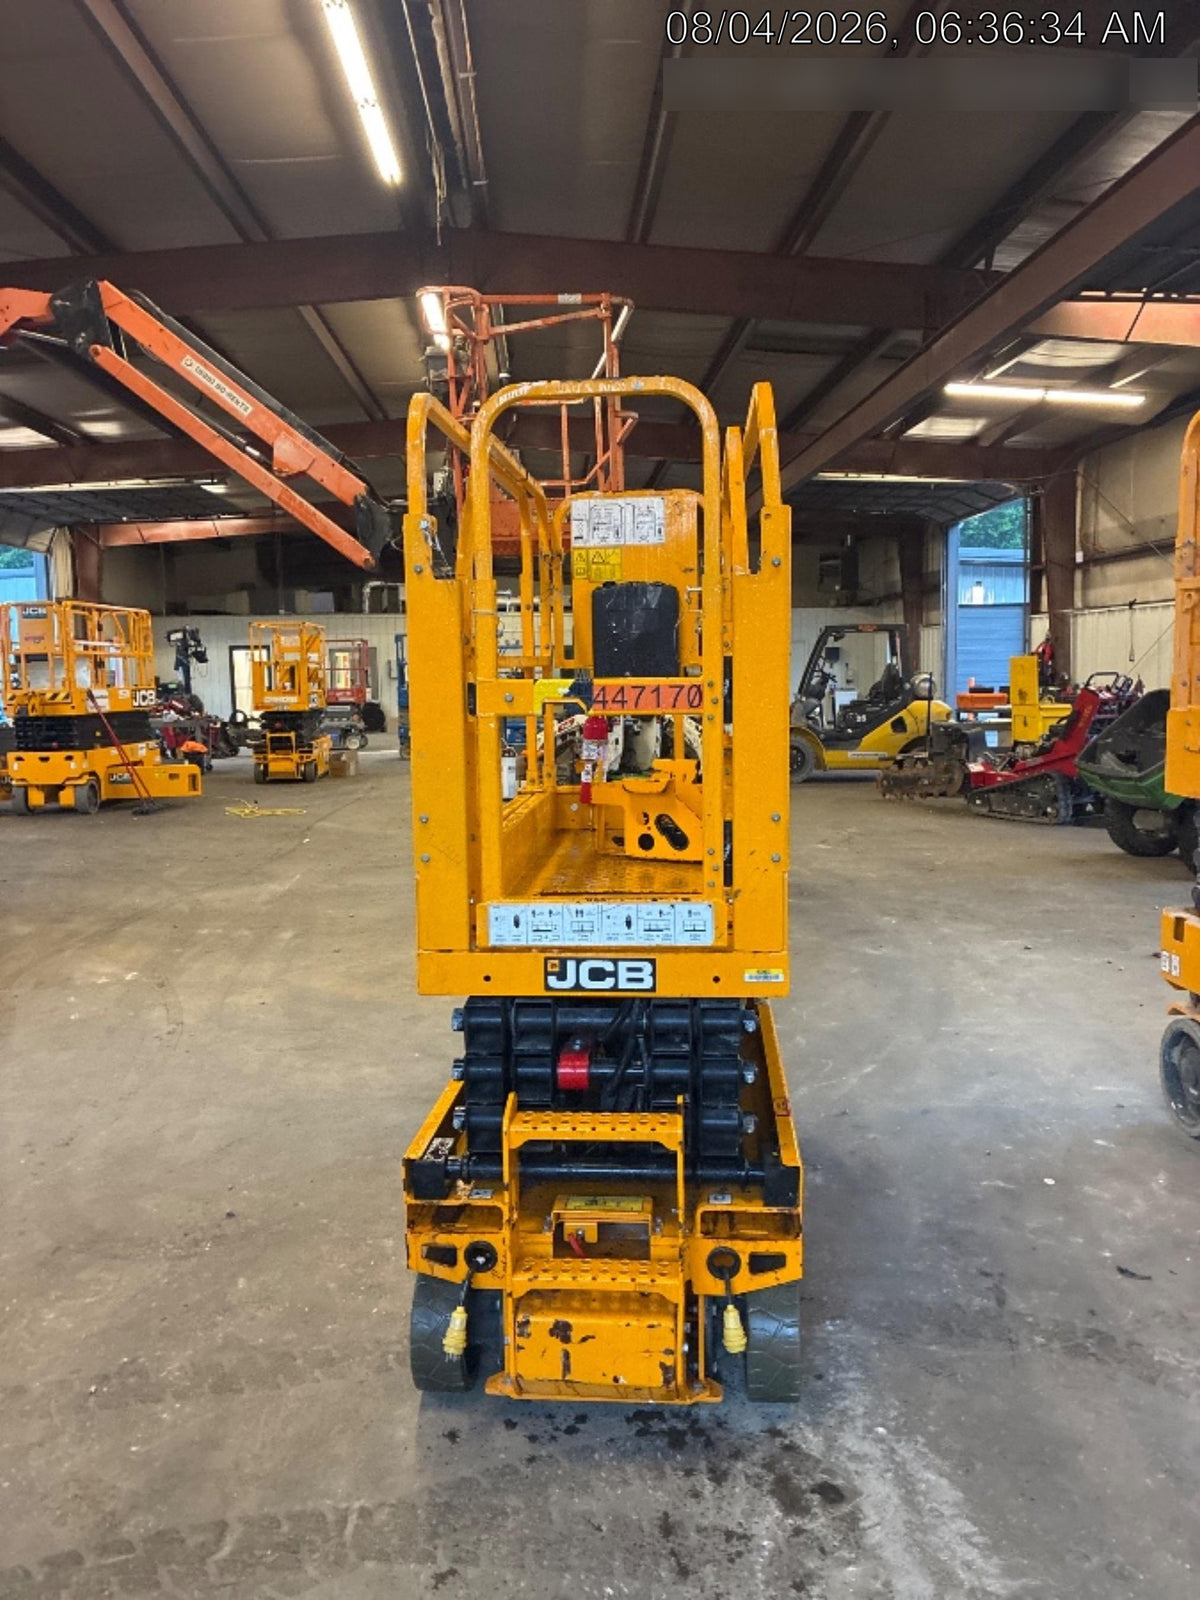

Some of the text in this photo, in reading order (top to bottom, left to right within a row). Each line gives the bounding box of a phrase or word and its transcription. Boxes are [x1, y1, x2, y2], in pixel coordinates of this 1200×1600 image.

[132, 689, 156, 706] JCB
[593, 684, 704, 709] 447170
[547, 959, 654, 989] JCB
